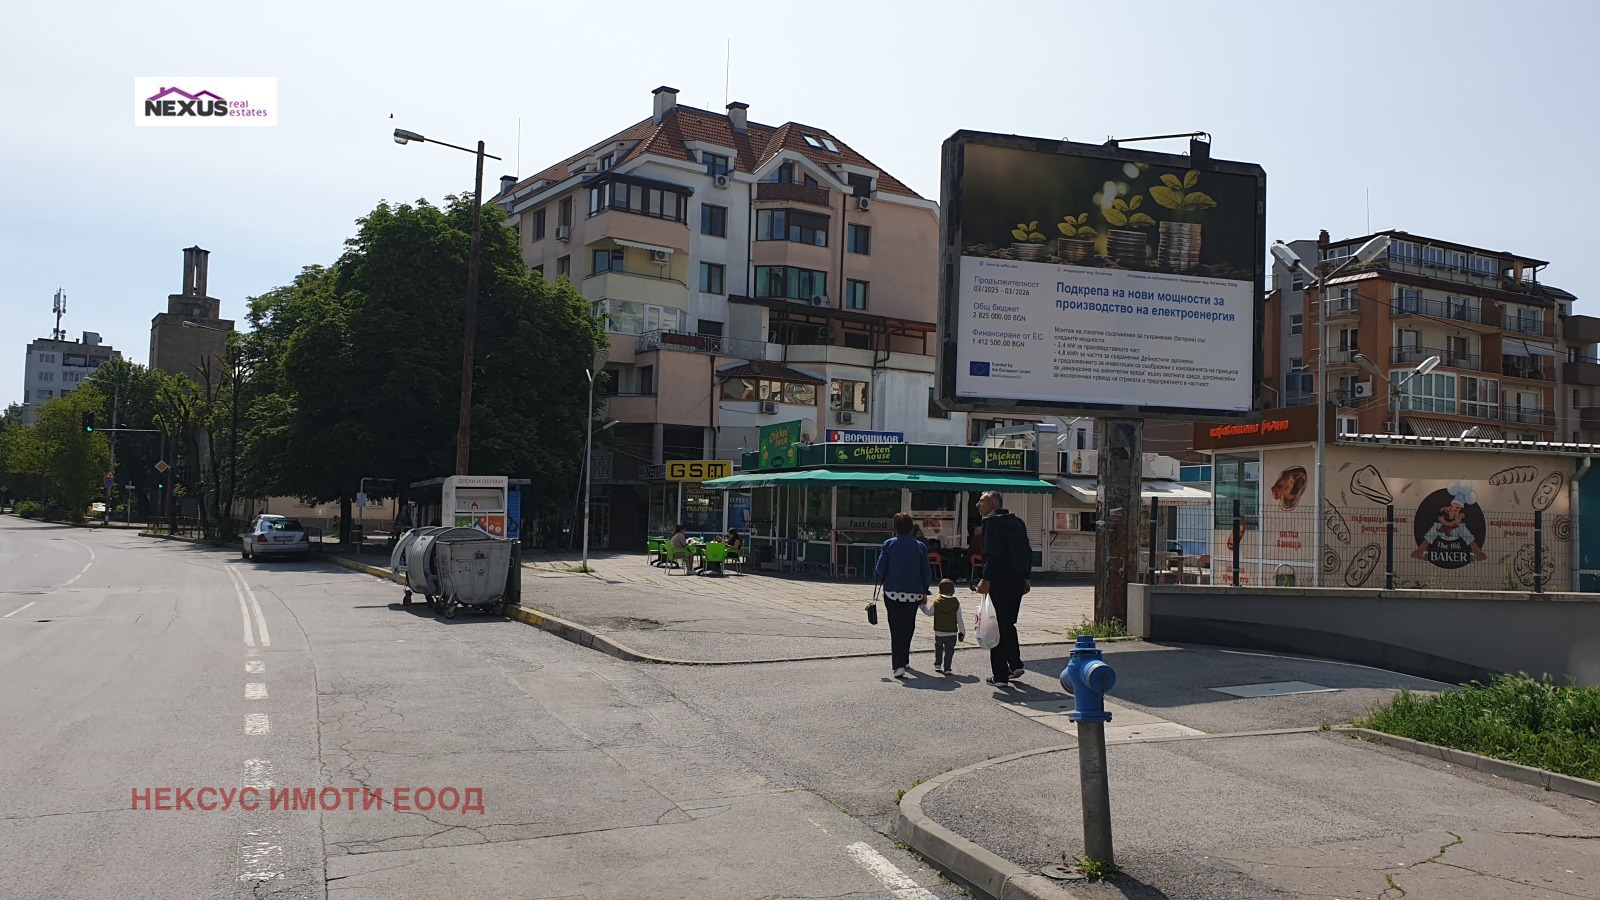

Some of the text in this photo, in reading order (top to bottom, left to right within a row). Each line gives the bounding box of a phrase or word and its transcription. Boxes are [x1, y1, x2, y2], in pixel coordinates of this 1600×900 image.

[974, 276, 1039, 288] Продължителност
[974, 285, 998, 293] 03/2025
[1005, 287, 1029, 296] 03/2026
[1056, 282, 1224, 306] Подкрепа на нови мощности за
[974, 302, 1019, 313] Общ бюджет
[1056, 300, 1235, 322] производство на електроенергия
[972, 328, 1021, 339] Финансиране
[845, 434, 898, 443] ВОРОШИЛОВ
[854, 446, 890, 457] Chicken
[866, 452, 890, 460] house
[987, 451, 1021, 462] Chicken
[671, 464, 724, 478] GSM
[850, 520, 887, 528] fast food
[1430, 552, 1468, 562] BAKER
